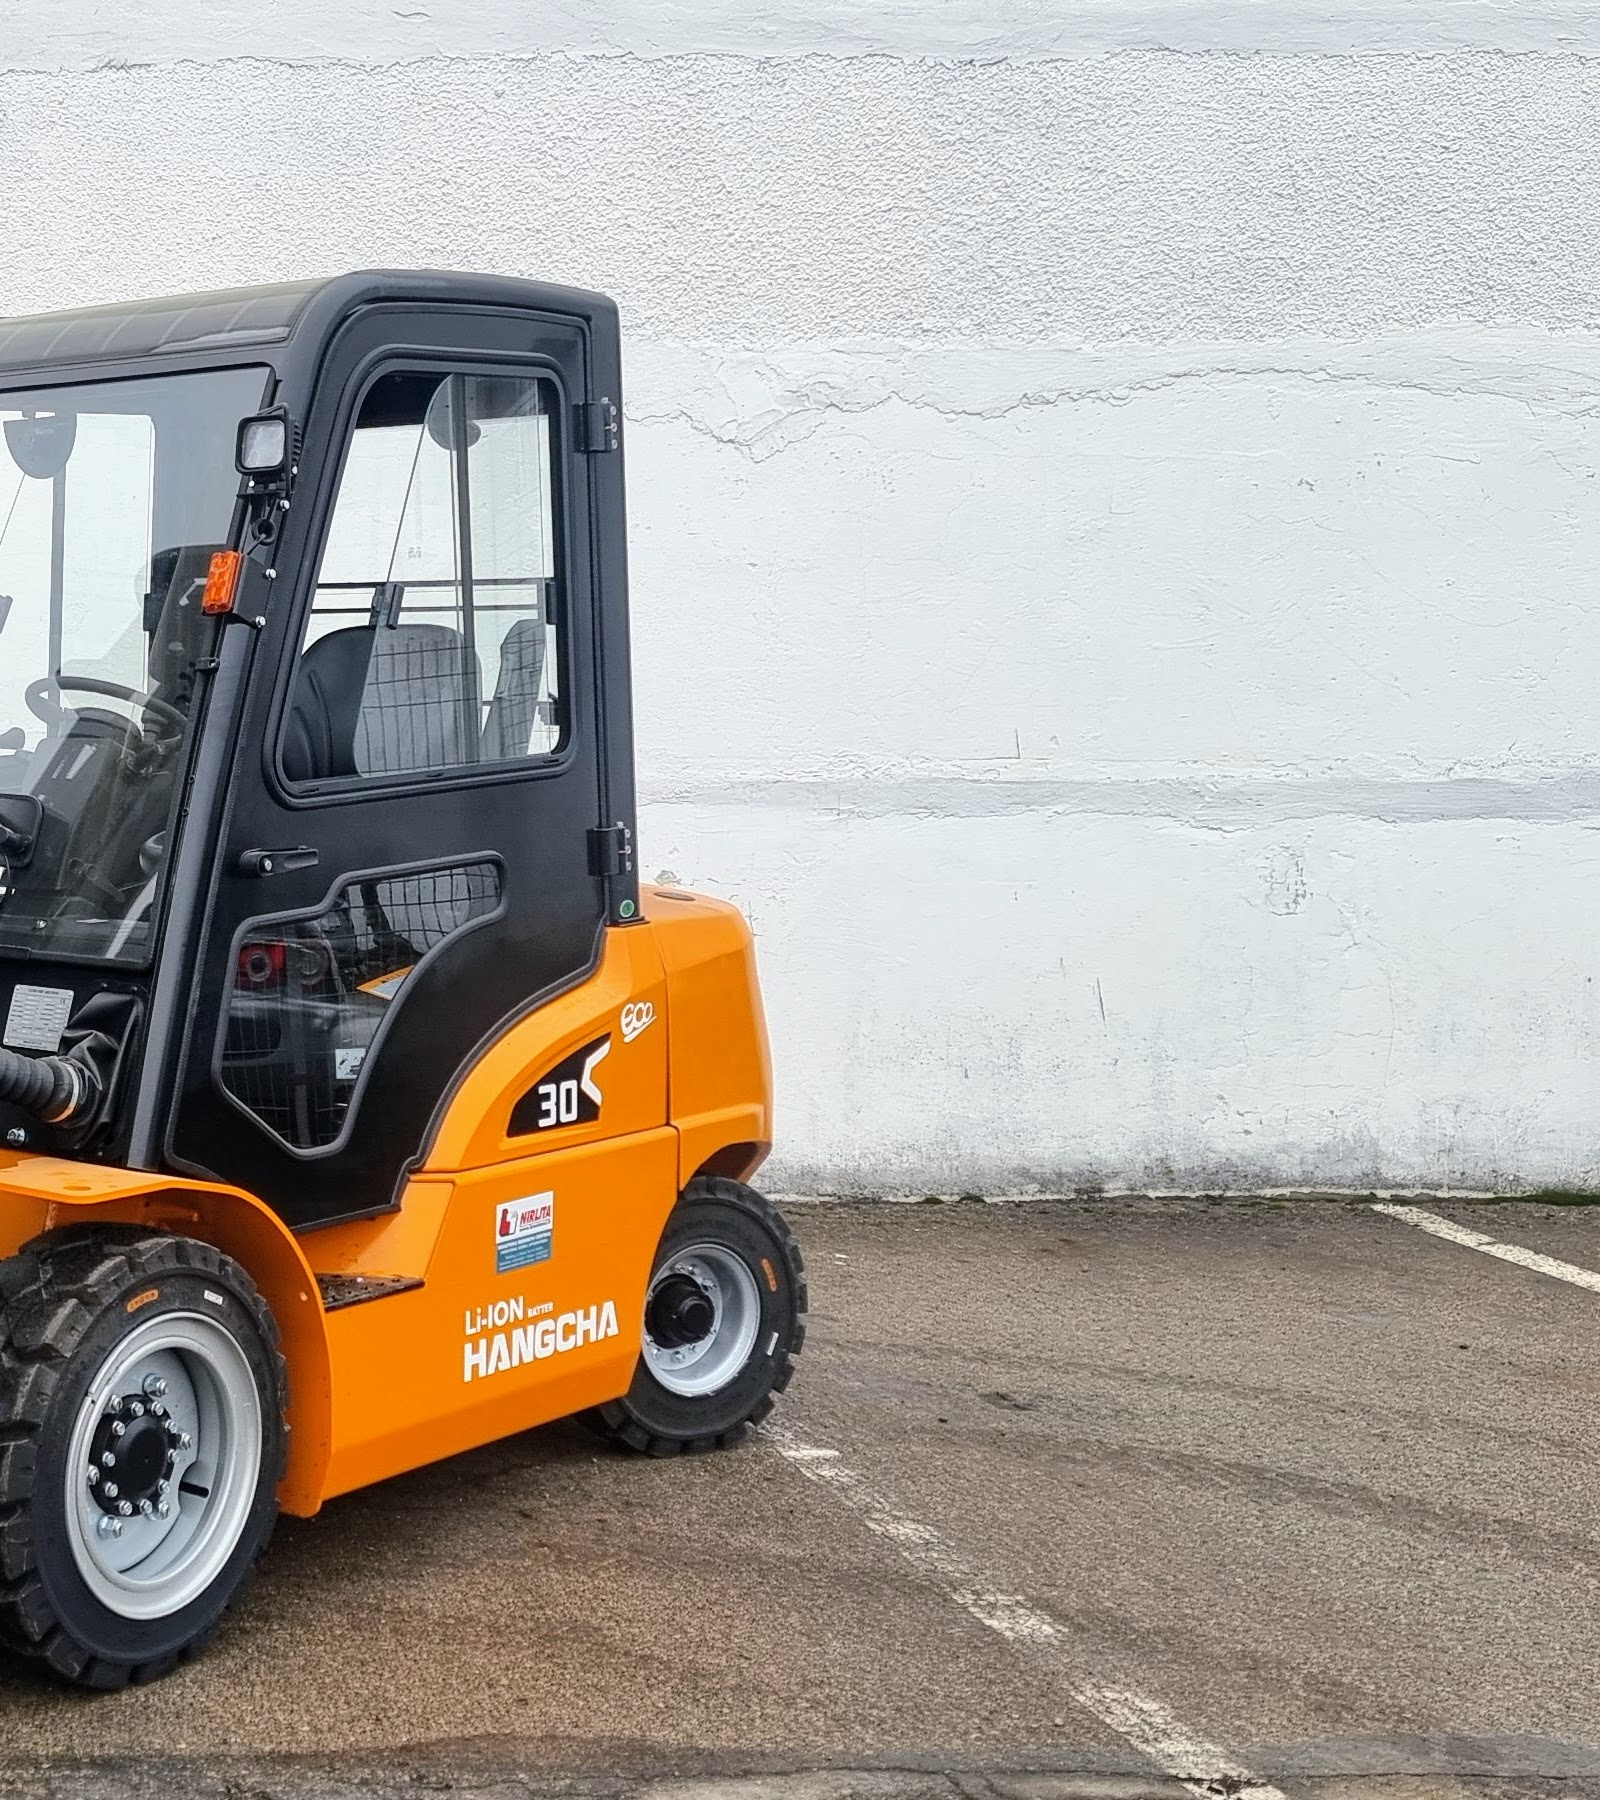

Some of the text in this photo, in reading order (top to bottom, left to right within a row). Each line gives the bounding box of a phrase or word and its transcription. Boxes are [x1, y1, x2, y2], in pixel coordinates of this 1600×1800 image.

[538, 1079, 578, 1128] 30
[465, 1295, 524, 1336] Li-ION
[463, 1300, 620, 1383] HANGCHA
